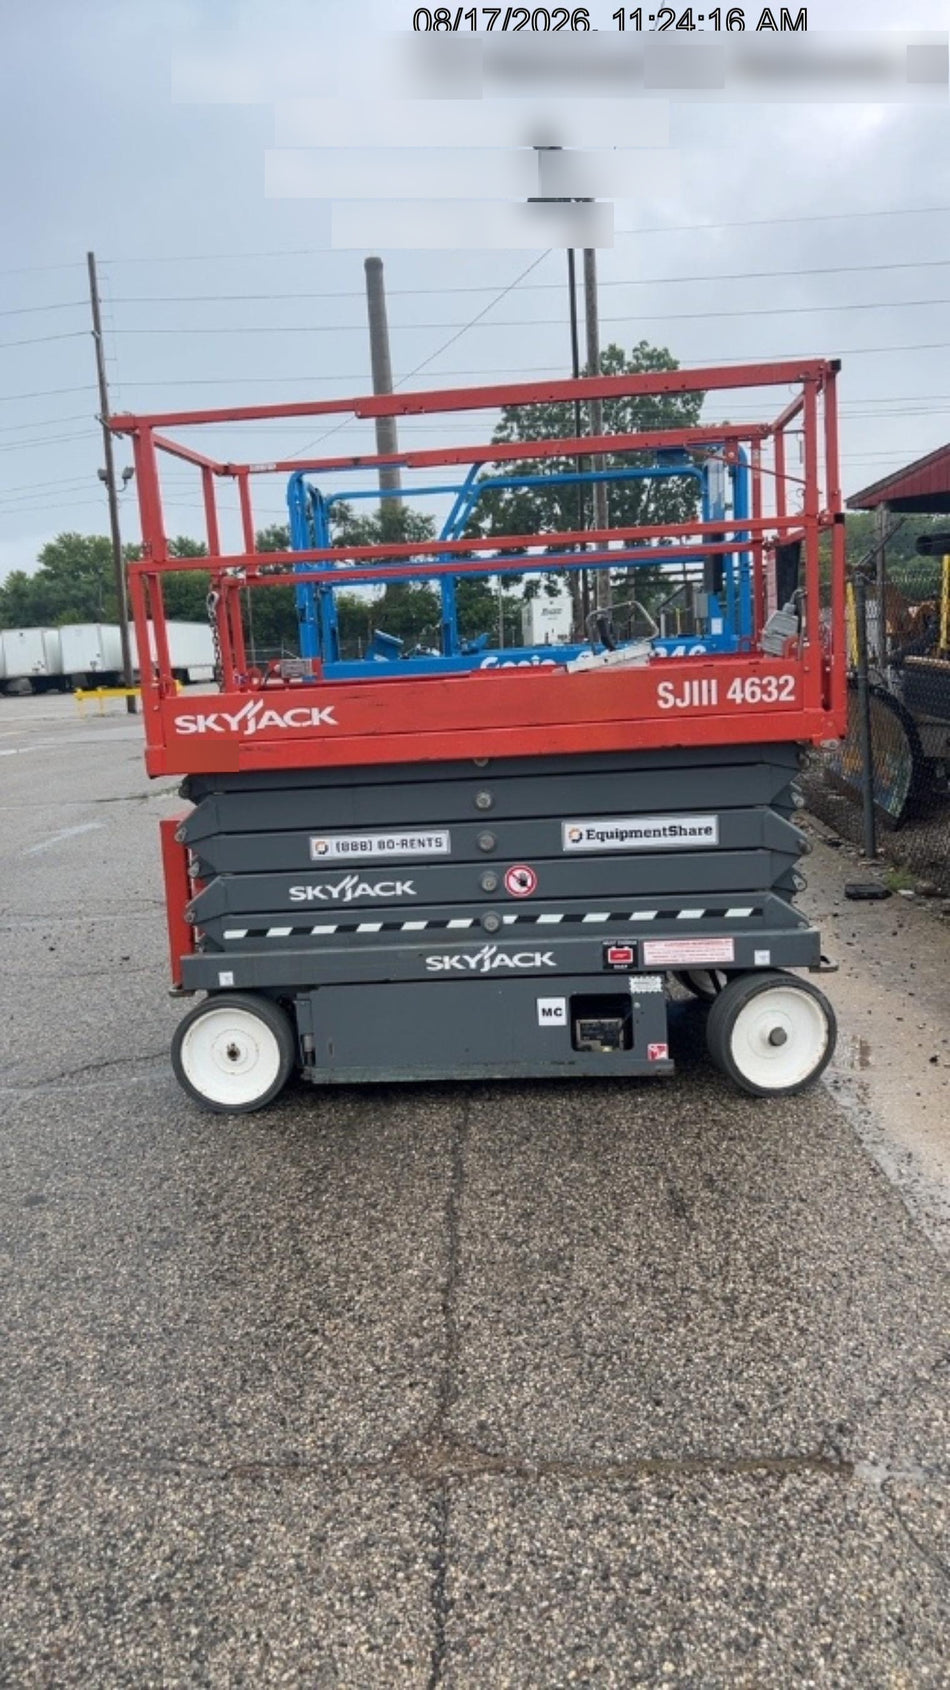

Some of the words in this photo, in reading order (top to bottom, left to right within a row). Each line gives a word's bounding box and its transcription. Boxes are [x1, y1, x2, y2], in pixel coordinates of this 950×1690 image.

[657, 679, 718, 709] SJIII
[726, 675, 796, 704] 4632
[174, 698, 339, 735] SKYJACK
[377, 837, 443, 850] 80-RENTS
[585, 825, 713, 842] EquipmentShare
[289, 874, 417, 902] SKYJACK
[425, 945, 557, 973] SKYJACK
[541, 1006, 563, 1018] MC
